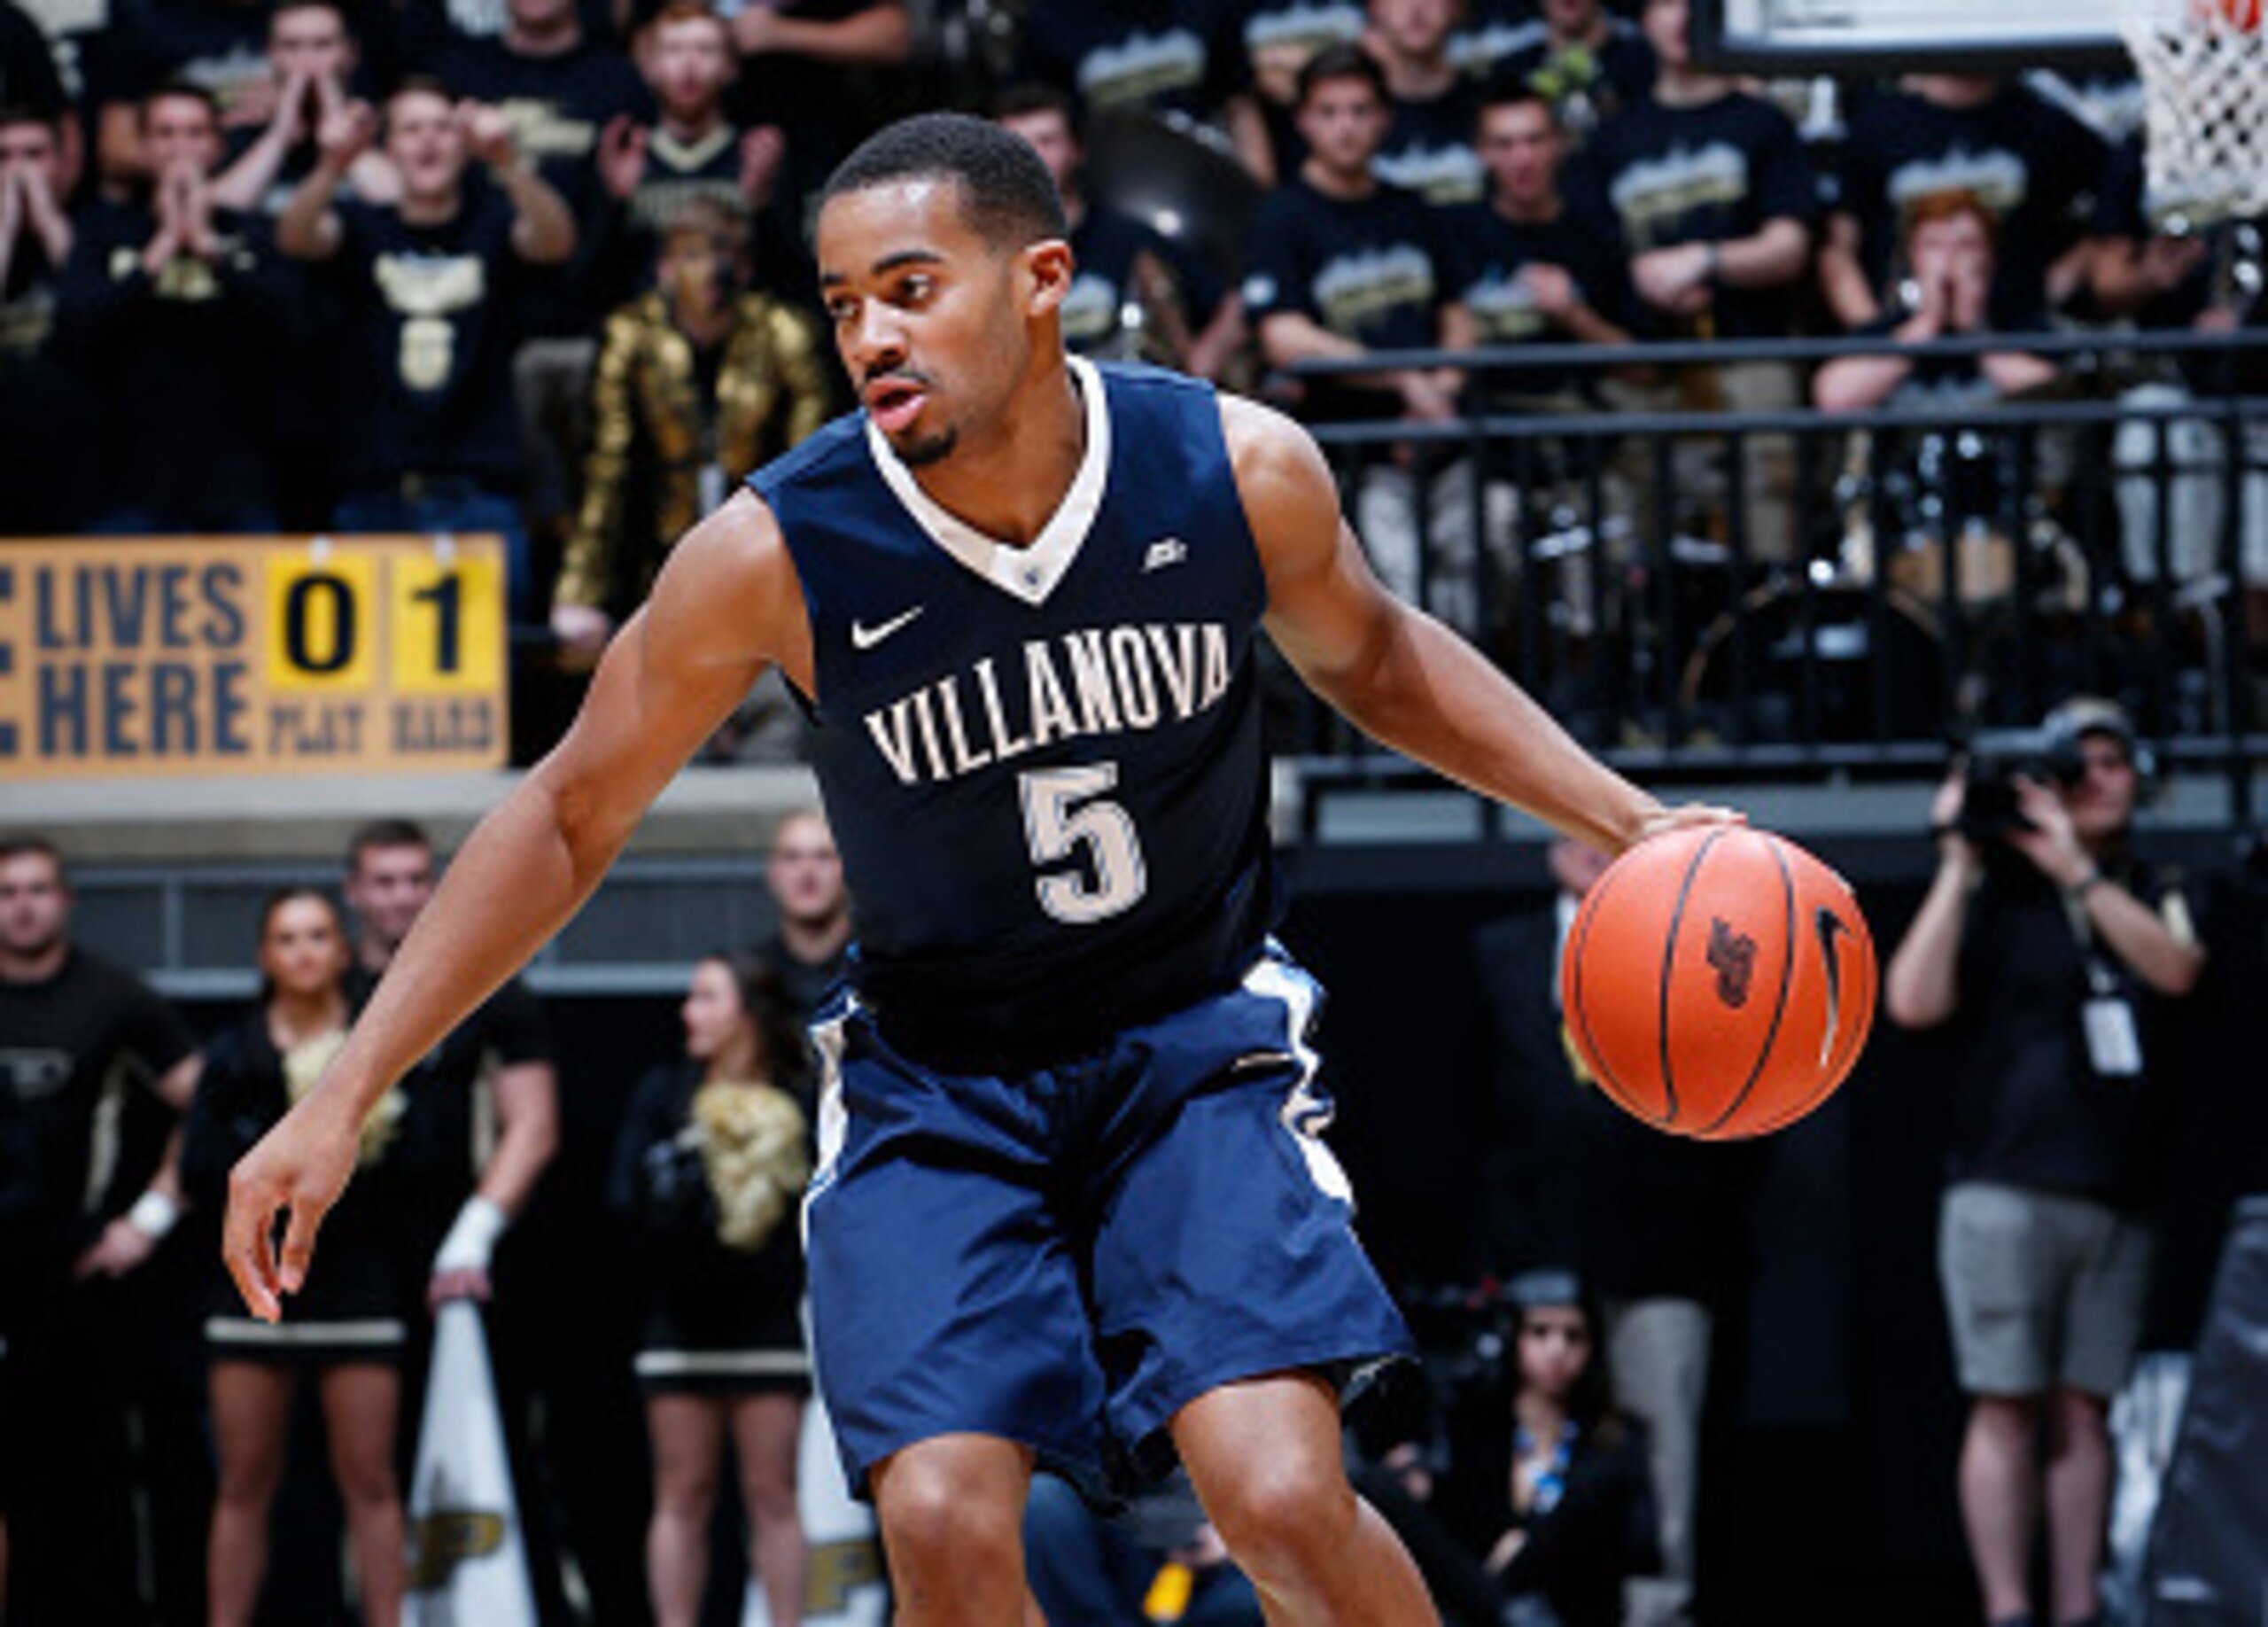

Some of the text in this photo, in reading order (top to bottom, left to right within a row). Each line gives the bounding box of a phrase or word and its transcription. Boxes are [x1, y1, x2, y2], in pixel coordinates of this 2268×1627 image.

[35, 564, 245, 649] LIVES
[36, 661, 248, 757] HERE
[268, 704, 364, 755] PLAY
[863, 623, 1233, 785] VILLANOVA
[1016, 759, 1147, 925] 5
